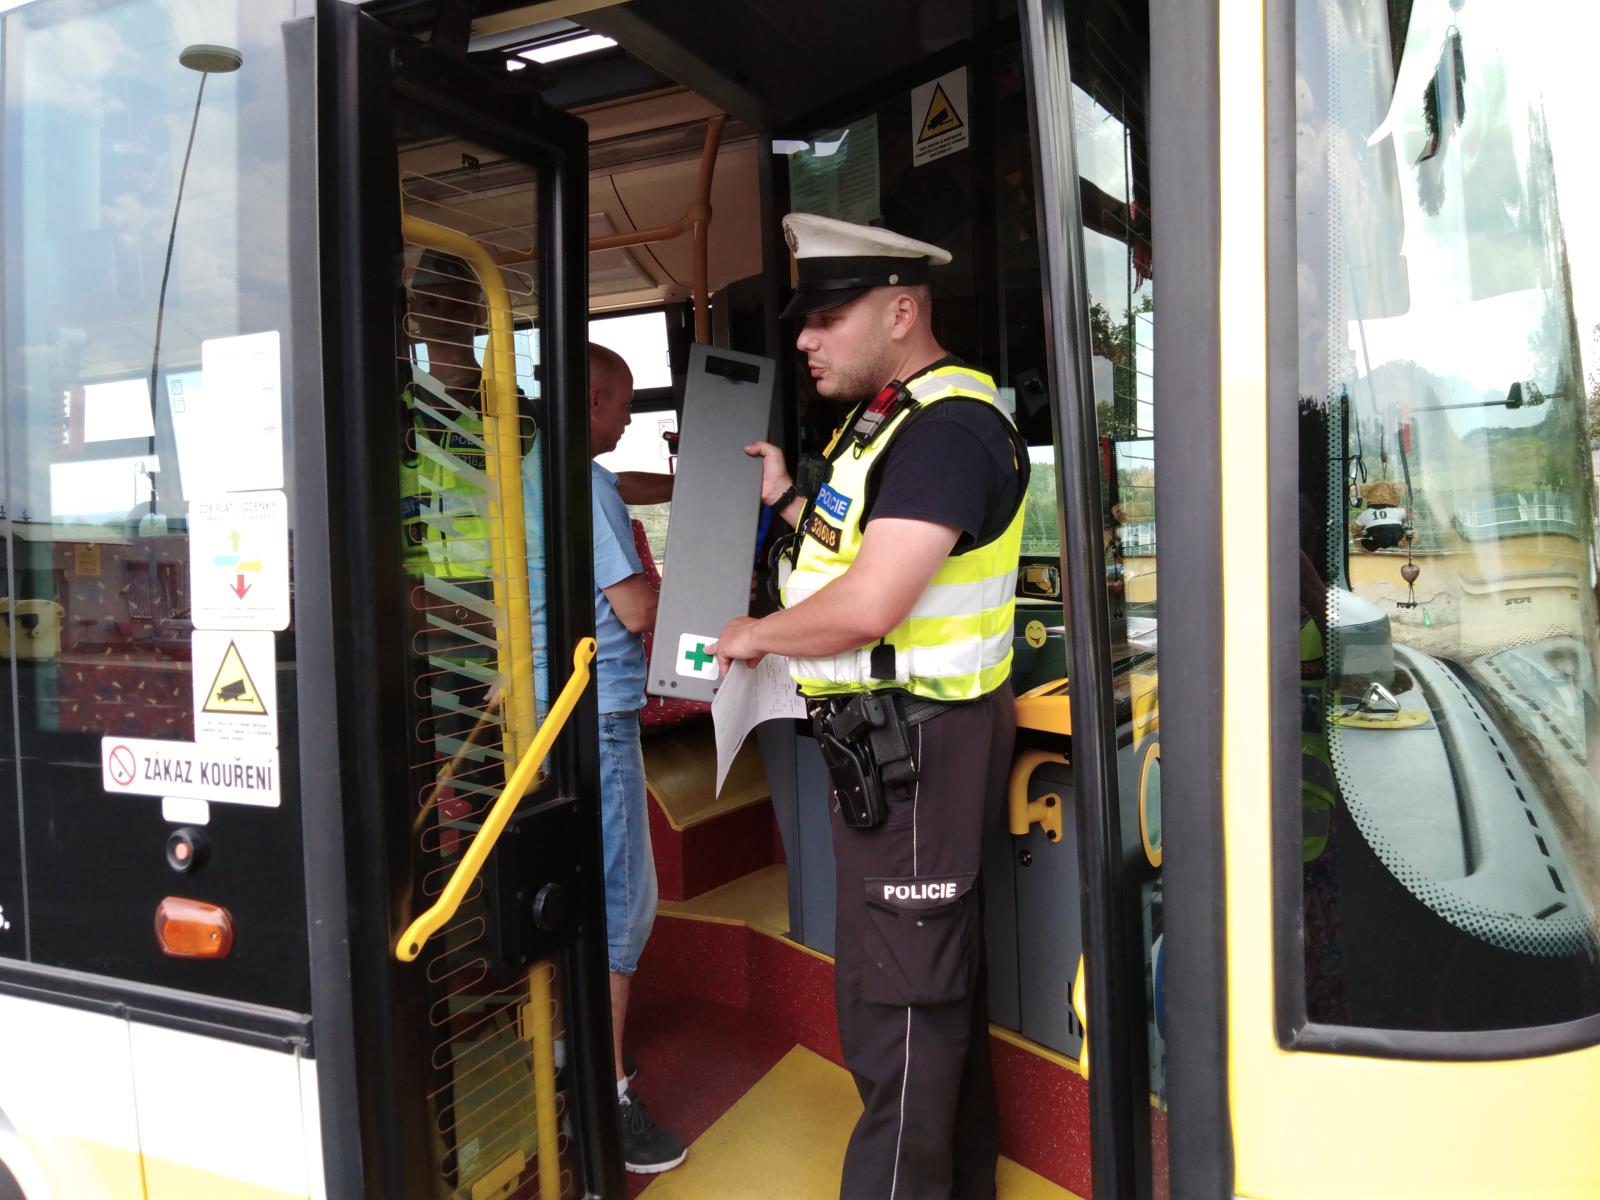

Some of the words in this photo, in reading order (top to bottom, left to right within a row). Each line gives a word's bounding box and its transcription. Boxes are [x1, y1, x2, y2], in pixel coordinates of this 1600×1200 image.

[817, 487, 848, 516] POCIE
[1372, 510, 1388, 520] 10
[143, 752, 193, 784] ZÁKAZ
[200, 756, 273, 791] KOUŘENÍ
[883, 882, 957, 900] POLICIE
